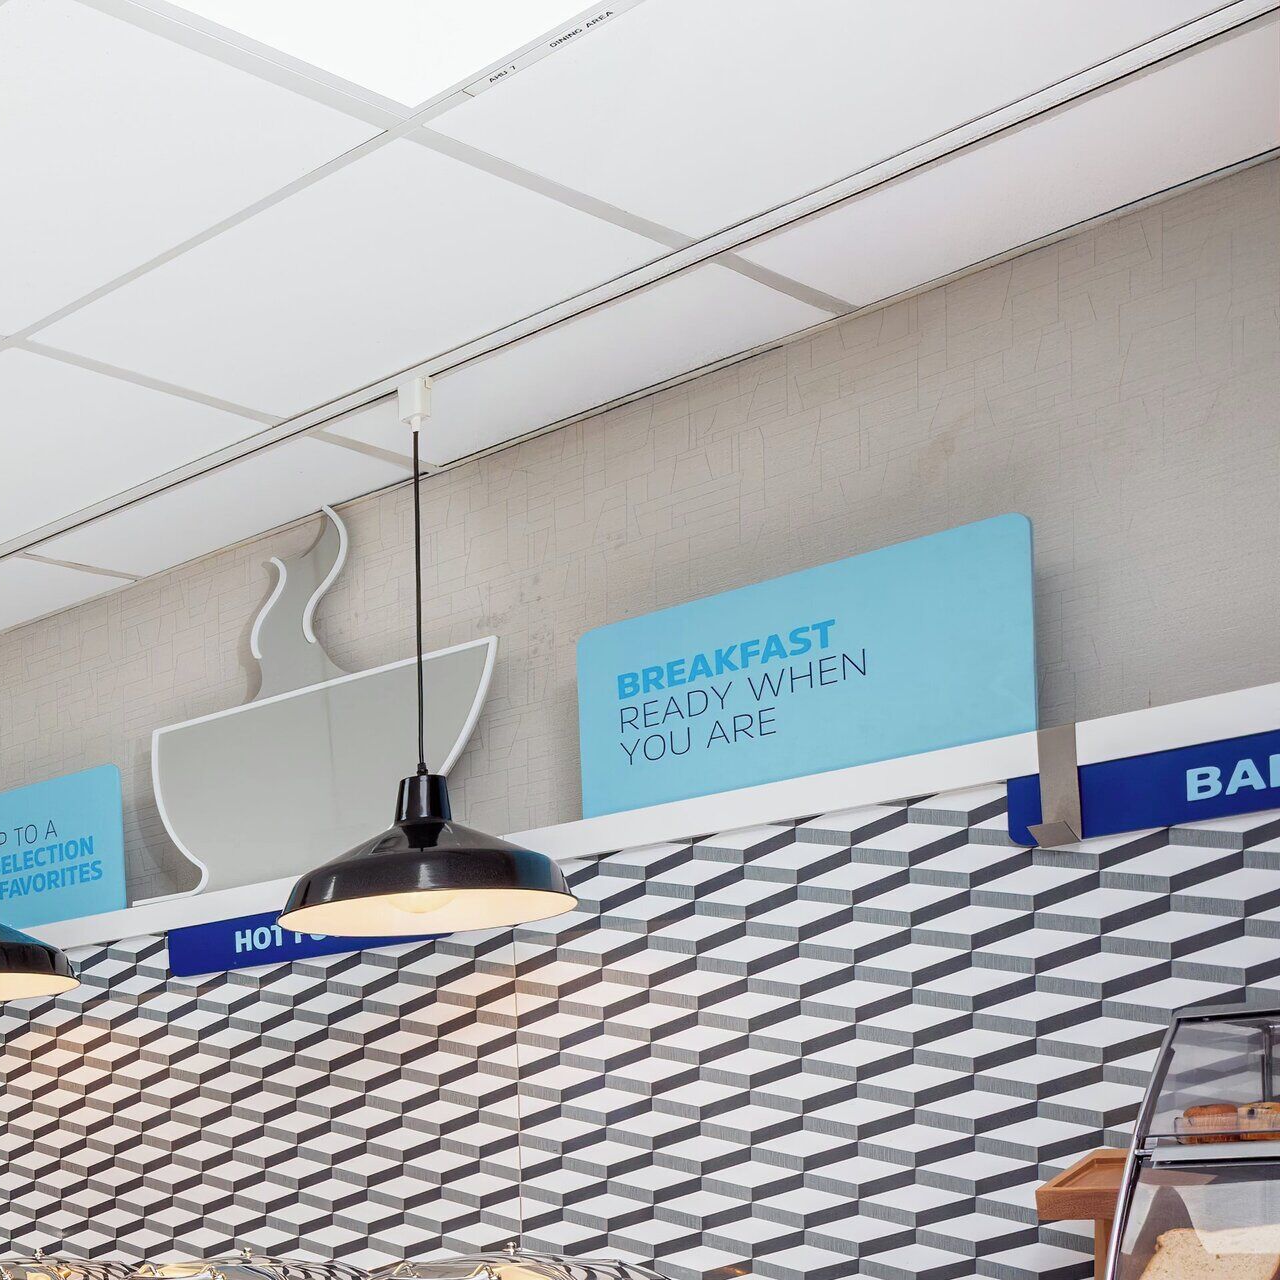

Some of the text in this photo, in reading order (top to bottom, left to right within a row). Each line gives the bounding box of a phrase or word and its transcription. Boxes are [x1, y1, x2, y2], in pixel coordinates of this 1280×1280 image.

[549, 10, 613, 48] DINING AREA
[618, 619, 836, 700] BREAKFAST
[620, 648, 867, 734] READY WHEN
[620, 707, 777, 765] YOU ARE
[1186, 753, 1280, 802] BA
[14, 824, 38, 847] TO
[44, 819, 58, 840] A
[0, 860, 104, 900] FAVORITES
[235, 924, 282, 953] HOT
